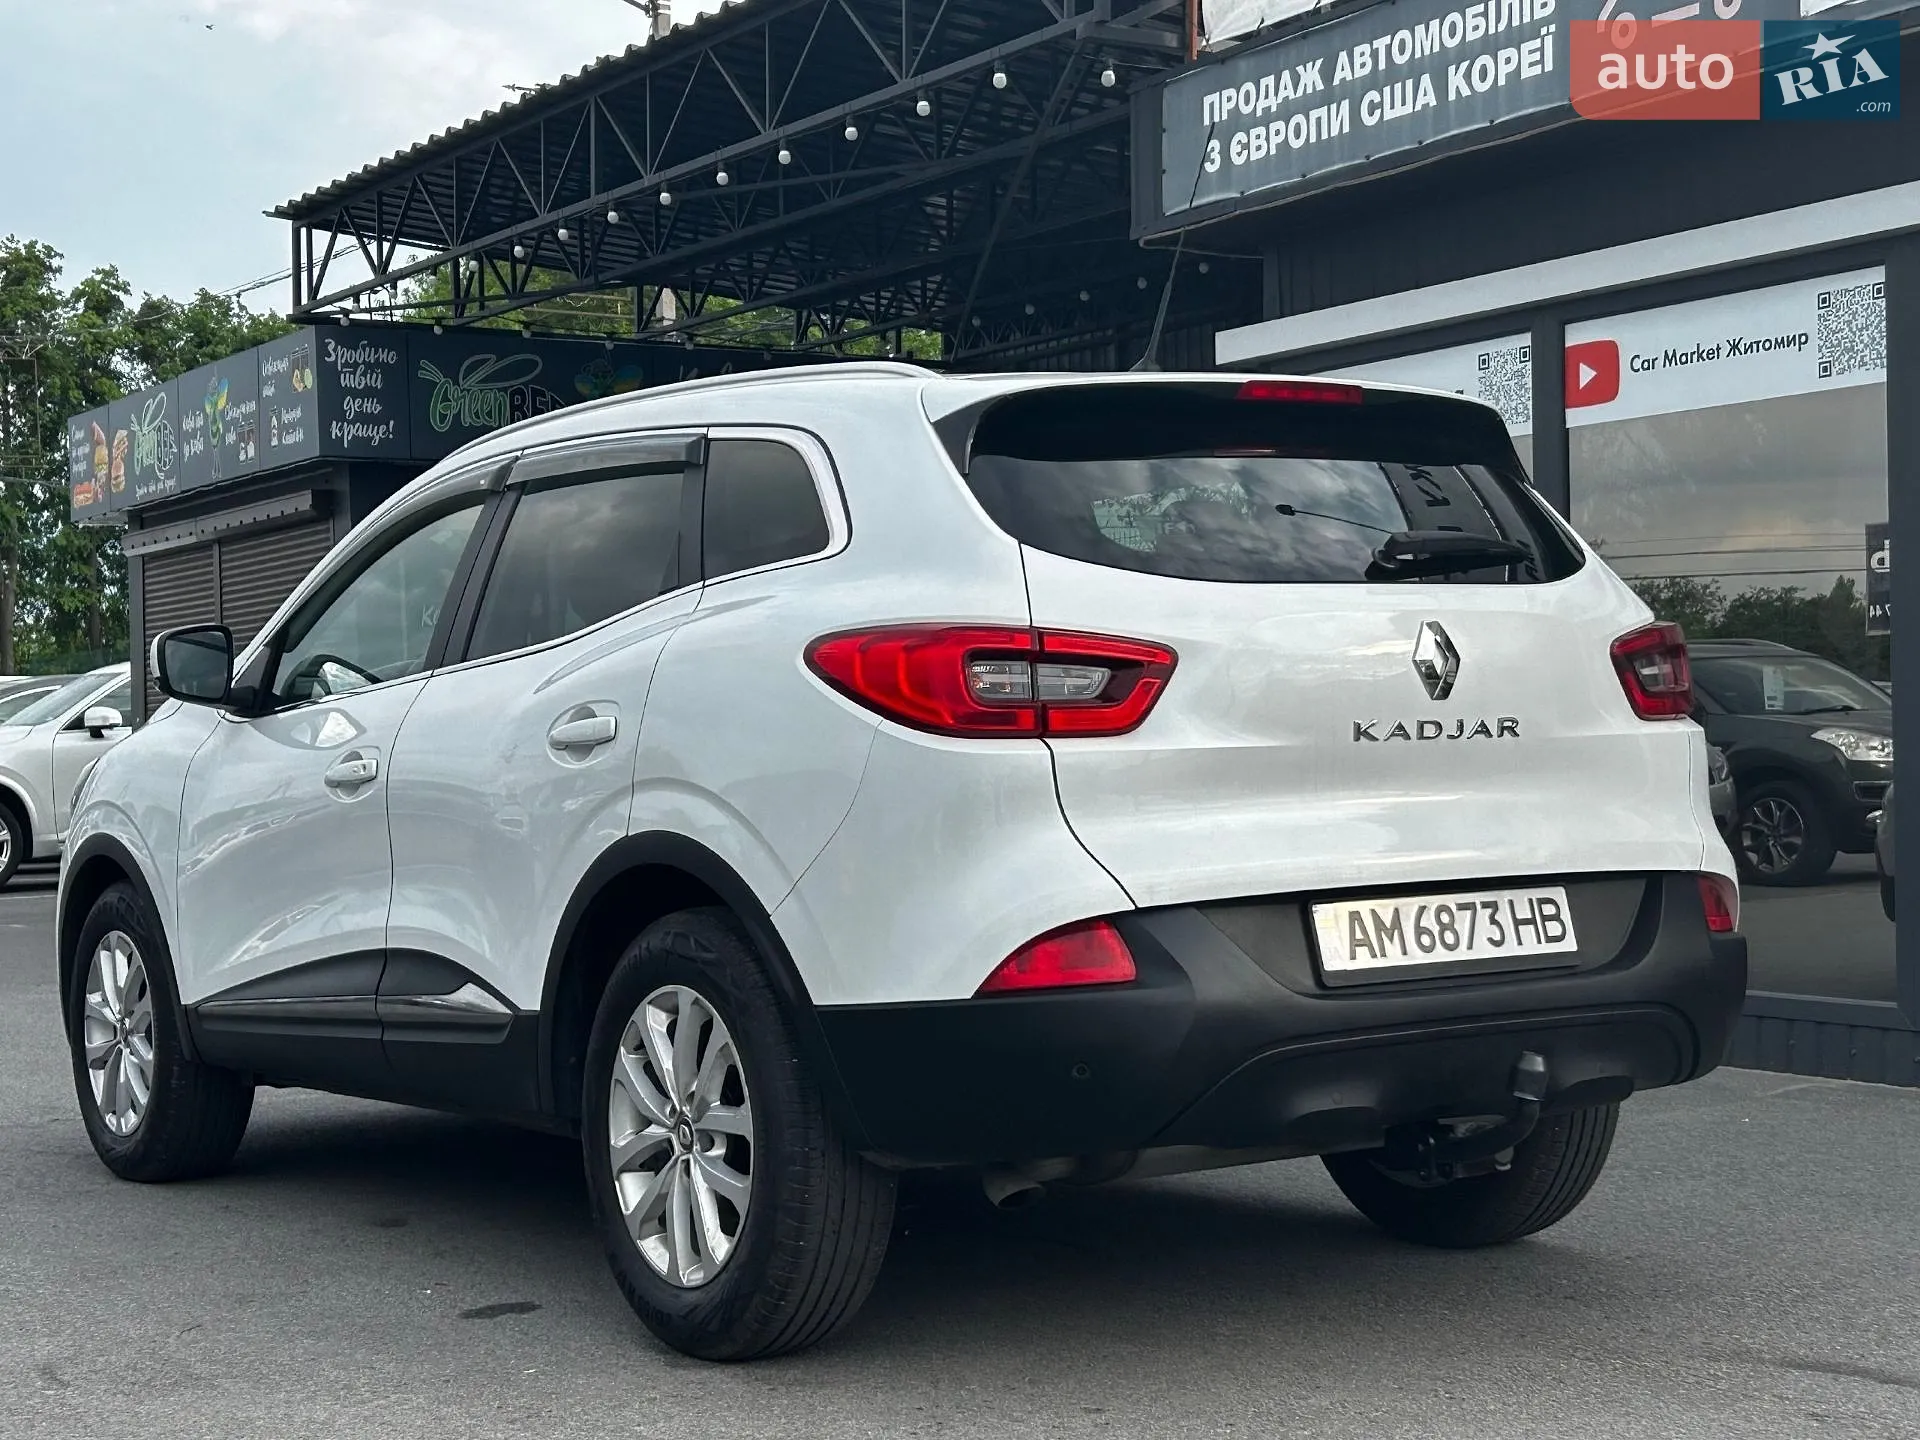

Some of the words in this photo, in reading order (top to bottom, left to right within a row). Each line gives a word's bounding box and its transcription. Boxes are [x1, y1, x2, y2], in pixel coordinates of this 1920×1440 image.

[1203, 58, 1324, 126] ПРОДАЖ
[1204, 139, 1222, 173] З
[1230, 98, 1350, 166] ЄВРОПИ
[1360, 73, 1438, 127] США
[1447, 24, 1556, 102] КОРЕЇ
[324, 338, 398, 371] Зробимо
[1630, 354, 1659, 373] Car
[1662, 343, 1722, 368] Market
[1726, 332, 1809, 358] Житомир
[340, 364, 384, 389] твій
[343, 395, 383, 420] день
[330, 420, 394, 448] краще!
[1352, 716, 1520, 742] KADJAR
[1413, 900, 1506, 954] 6873
